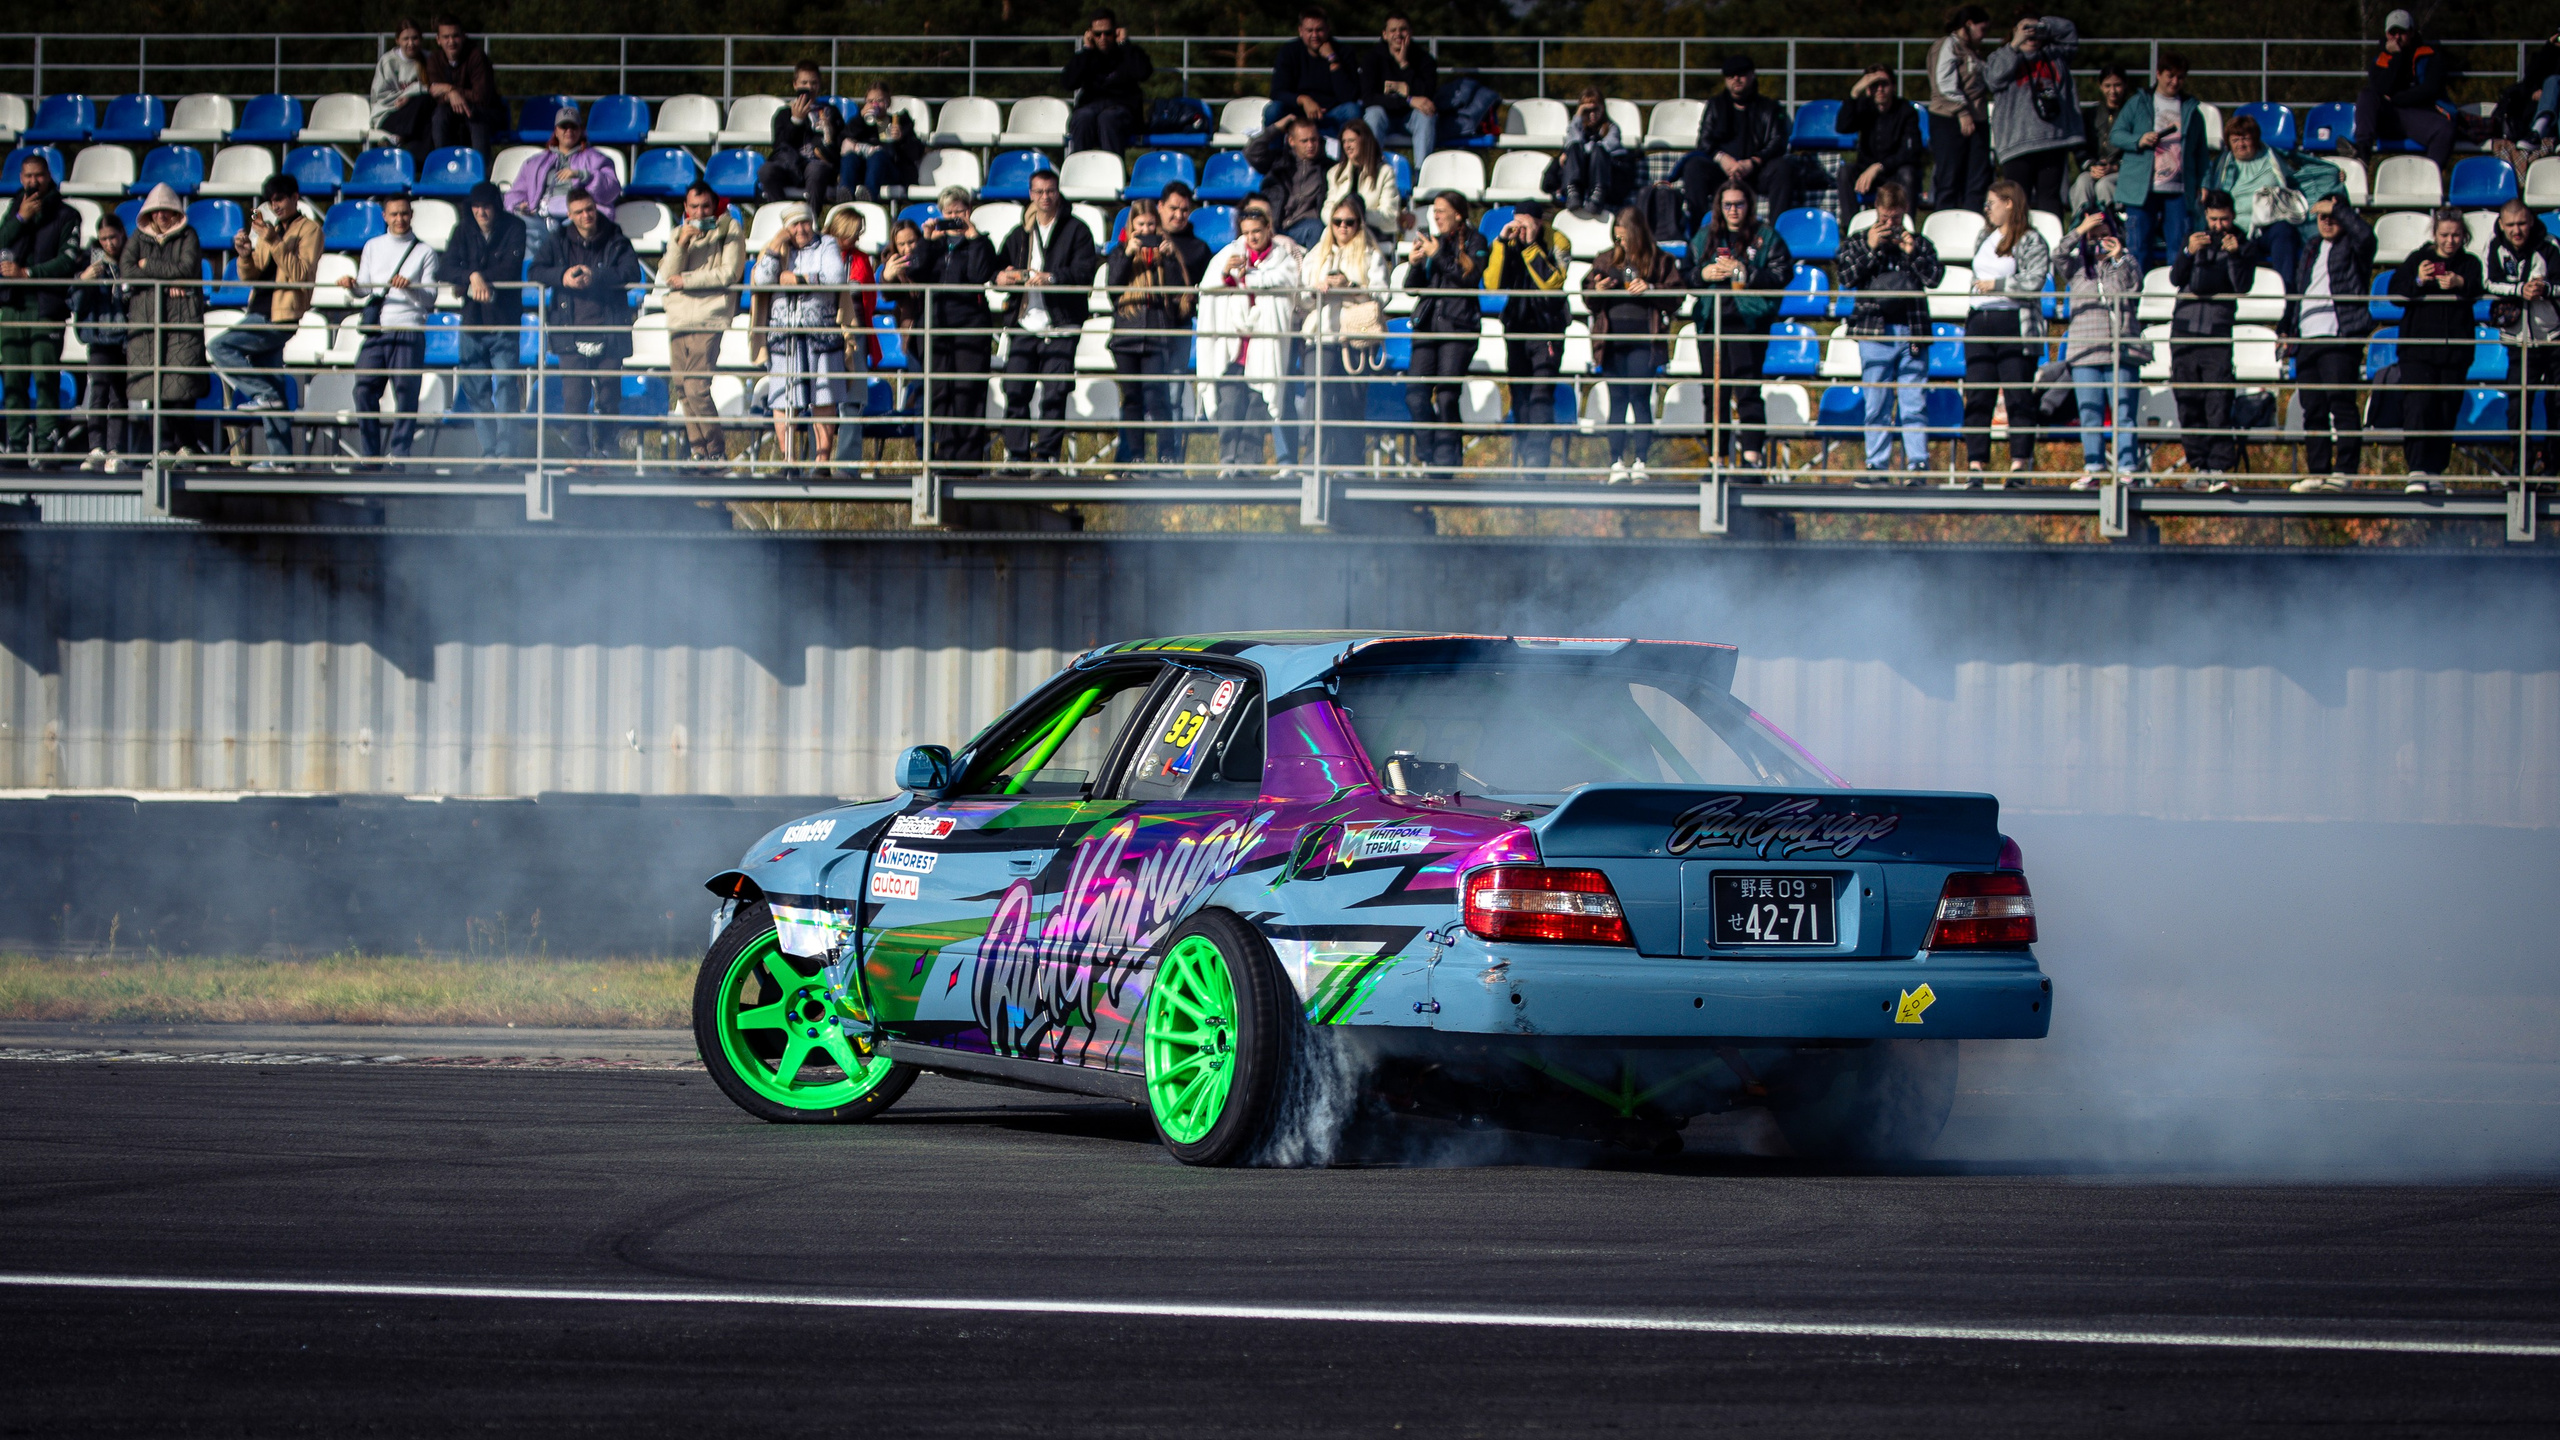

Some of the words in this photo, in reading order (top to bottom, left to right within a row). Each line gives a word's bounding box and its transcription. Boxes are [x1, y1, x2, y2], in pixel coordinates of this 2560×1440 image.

[1163, 709, 1206, 749] 93
[781, 819, 837, 843] usim999
[1367, 827, 1423, 841] ИНПРОМ
[1365, 838, 1402, 855] ТРЕЙД
[873, 872, 918, 896] auto.ru
[1778, 880, 1805, 898] 09
[1728, 913, 1744, 931] せ
[1745, 903, 1818, 940] 42-71
[1902, 991, 1930, 1019] TOW
